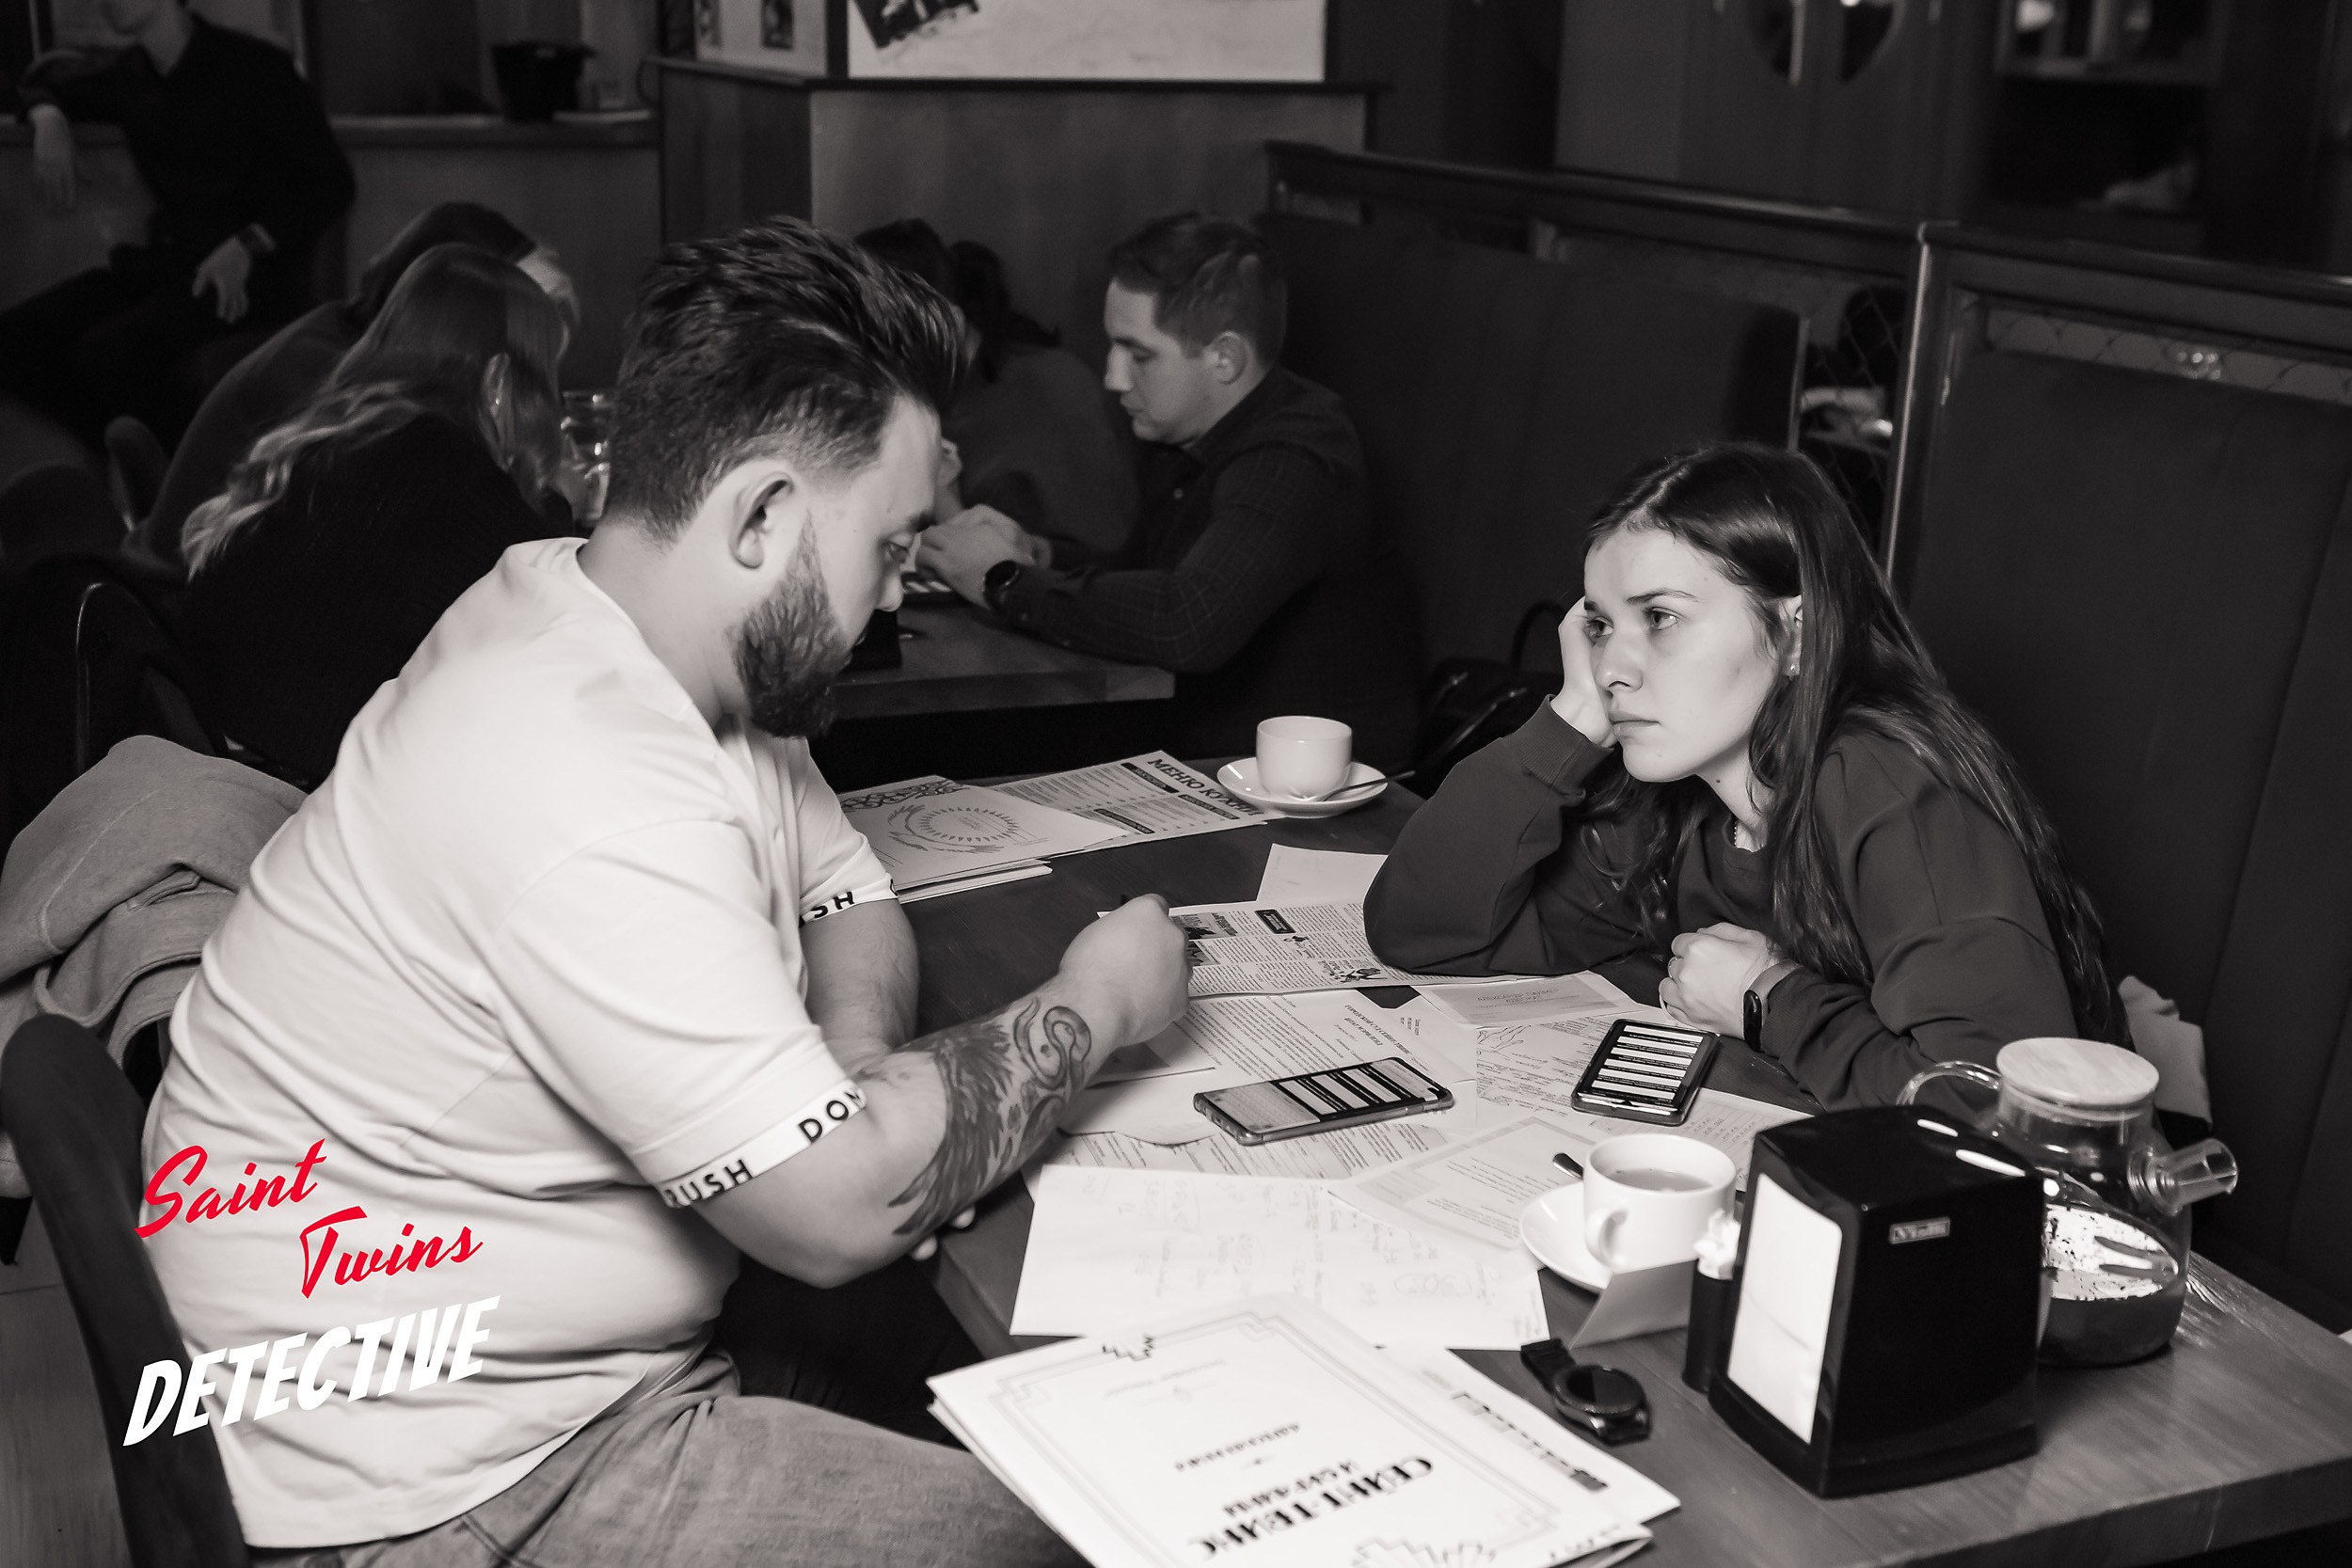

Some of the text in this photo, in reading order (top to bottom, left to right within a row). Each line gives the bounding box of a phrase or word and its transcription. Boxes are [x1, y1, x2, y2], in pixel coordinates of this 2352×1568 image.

[1147, 758, 1205, 789] МЕНЮ
[1199, 788, 1264, 816] КУХНИ
[799, 891, 854, 928] SH
[1188, 1457, 1433, 1560] СЕЙНТ-ТВИНС
